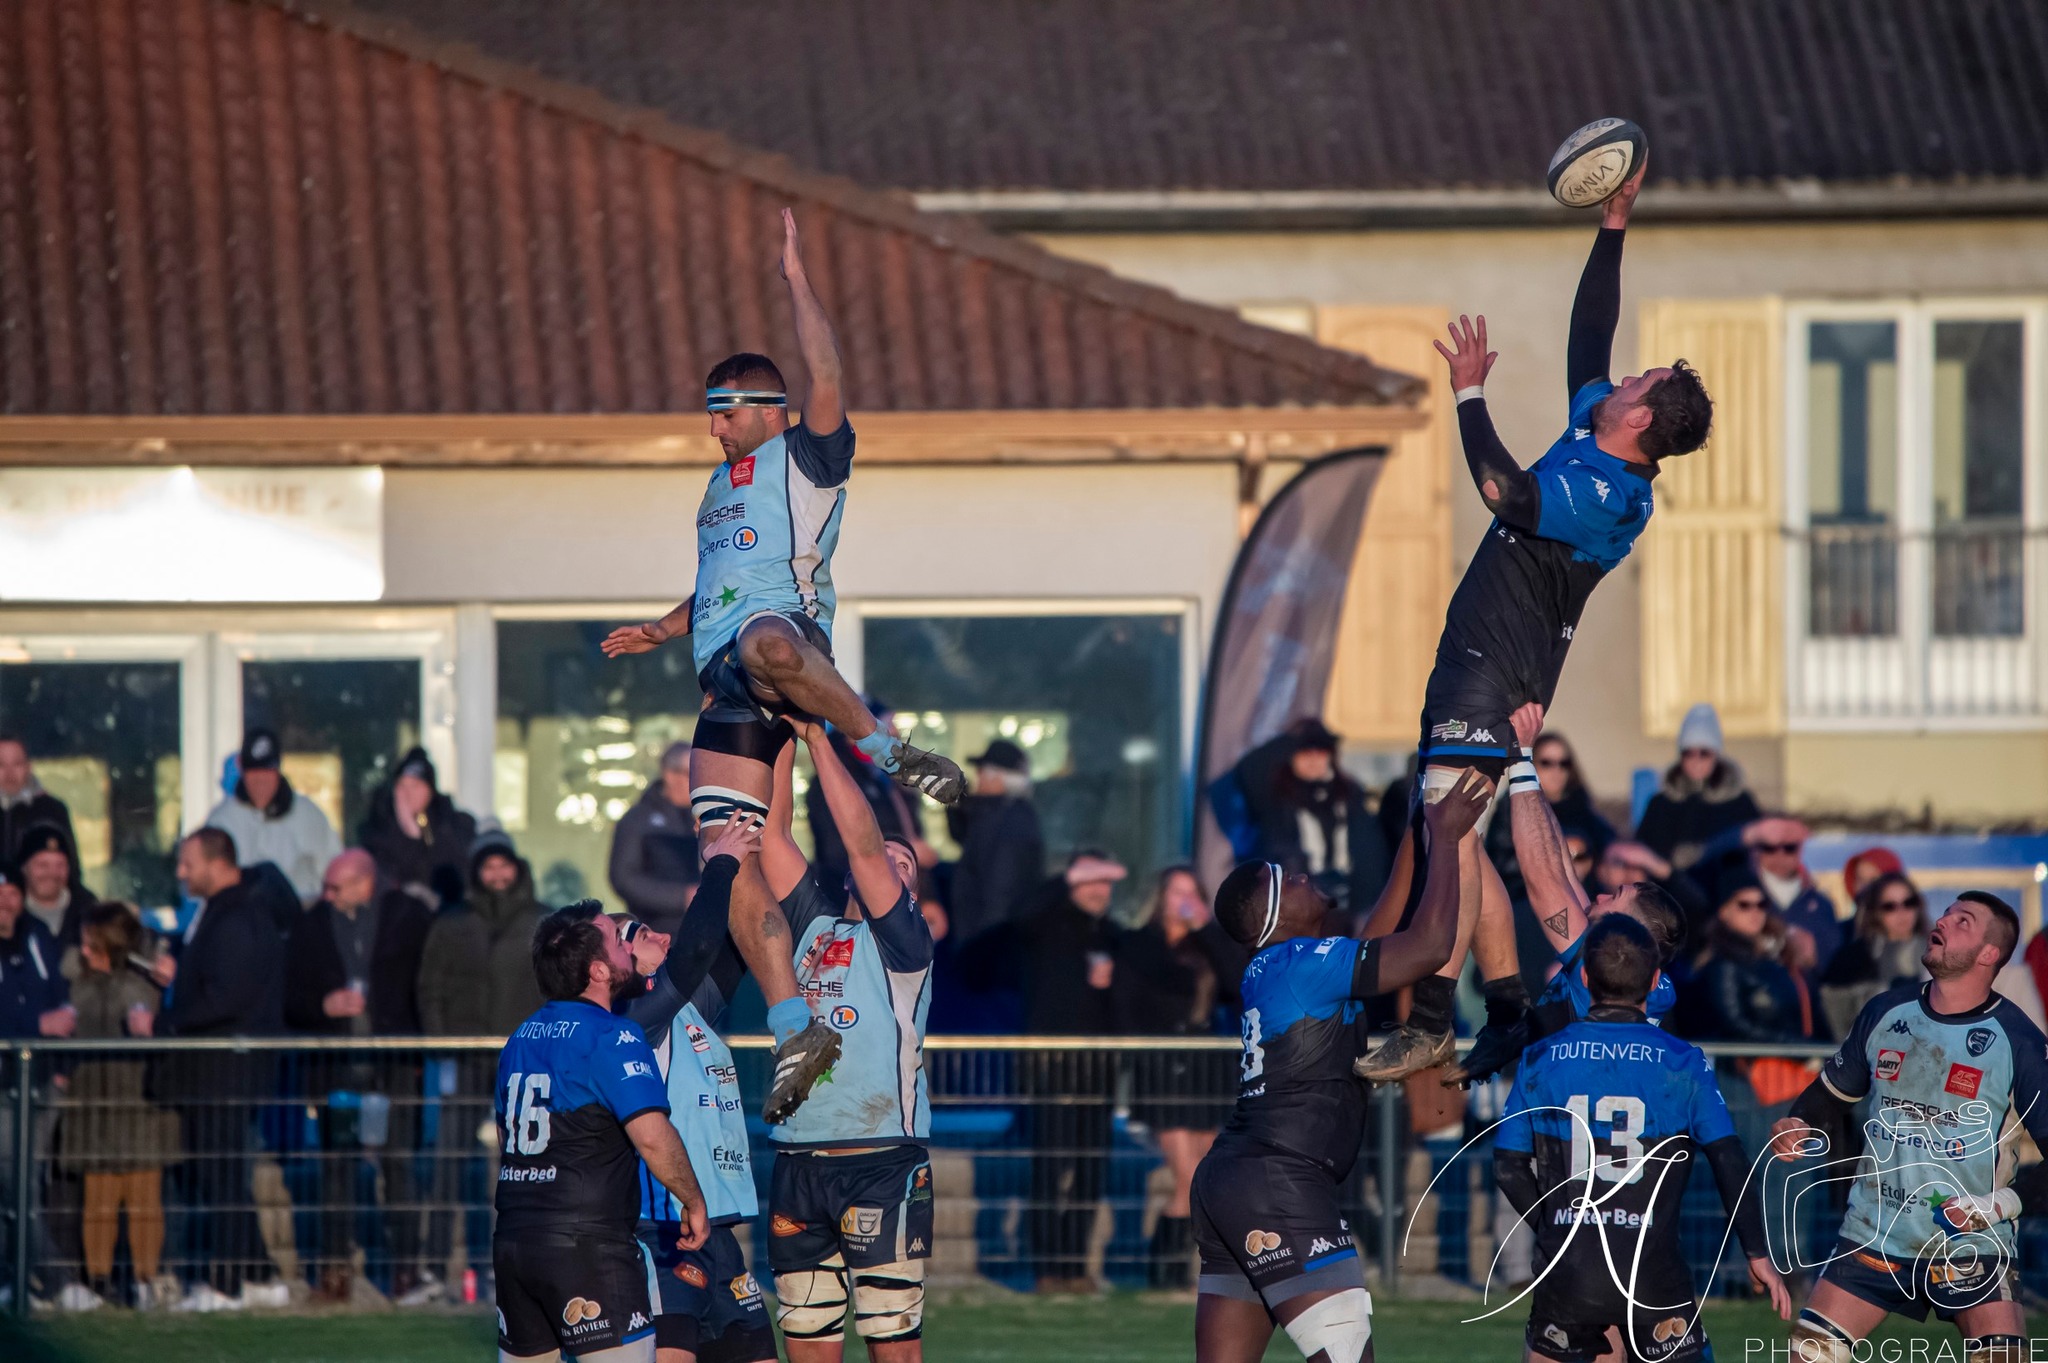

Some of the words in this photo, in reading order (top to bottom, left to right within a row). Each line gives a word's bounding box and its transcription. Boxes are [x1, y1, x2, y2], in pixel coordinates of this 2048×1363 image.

[1568, 164, 1615, 201] VINAY
[514, 1021, 581, 1039] OUTENVERT
[1550, 1041, 1666, 1064] TOUTENVERT
[1877, 1060, 1900, 1070] DARTY
[505, 1072, 551, 1156] 16
[1564, 1094, 1646, 1185] 13
[499, 1165, 557, 1181] isterBed
[1258, 1248, 1293, 1265] RIVIERE
[573, 1319, 611, 1336] RIVIERE
